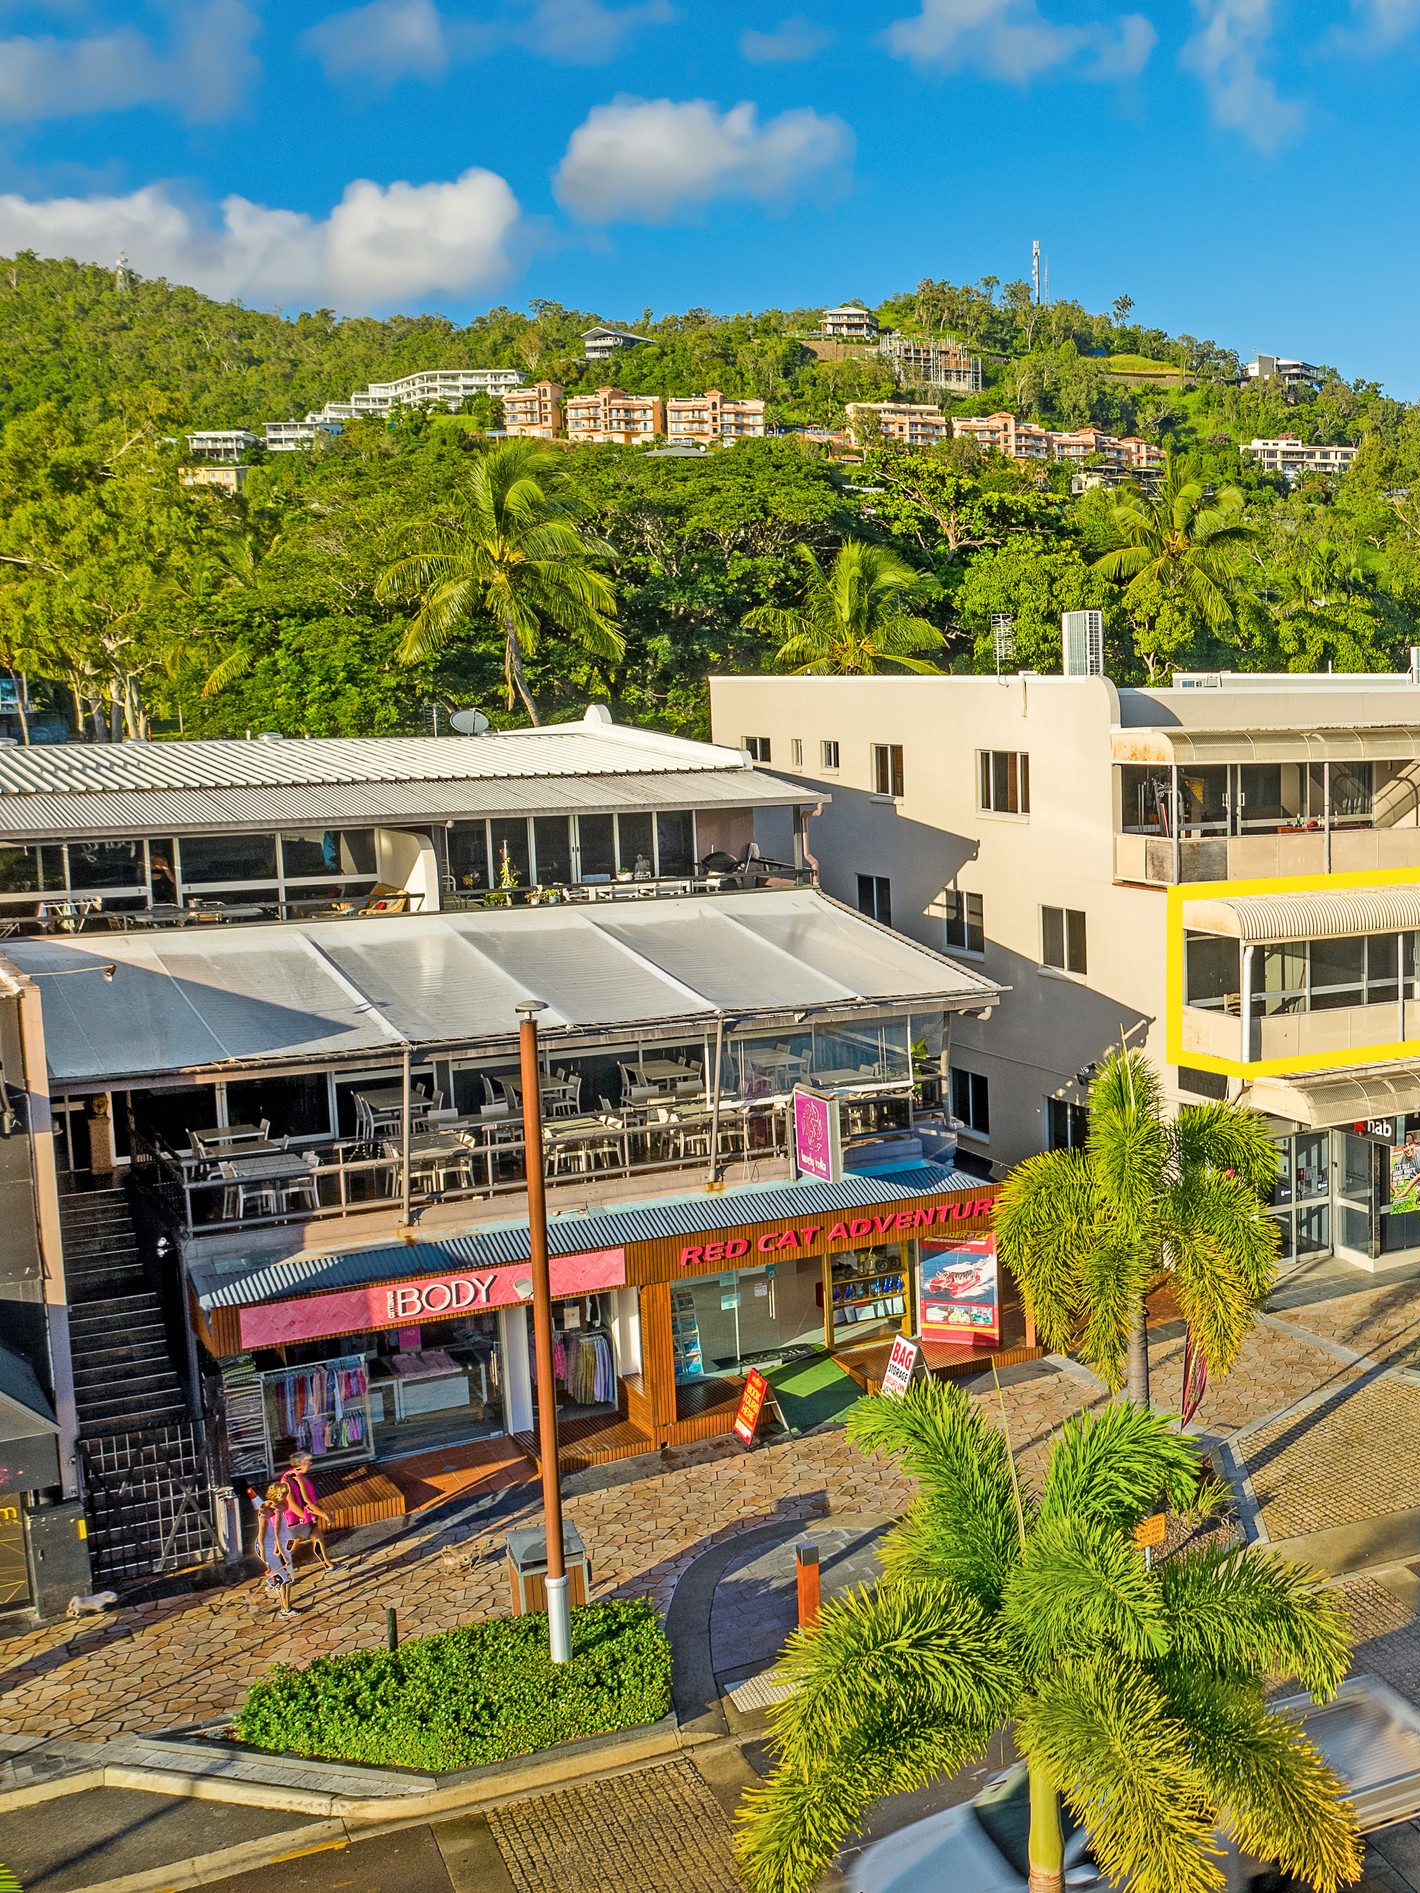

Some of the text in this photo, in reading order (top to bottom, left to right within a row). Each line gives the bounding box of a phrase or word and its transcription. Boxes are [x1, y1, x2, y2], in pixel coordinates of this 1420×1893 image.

[1367, 1119, 1392, 1137] nab
[680, 1238, 749, 1266] RED
[757, 1226, 822, 1252] CAT
[397, 1274, 496, 1317] BODY
[892, 1342, 914, 1371] BAG
[888, 1363, 908, 1383] STORAGE
[743, 1392, 760, 1413] TOURS
[746, 1383, 761, 1402] BOOK
[741, 1403, 755, 1422] HERE
